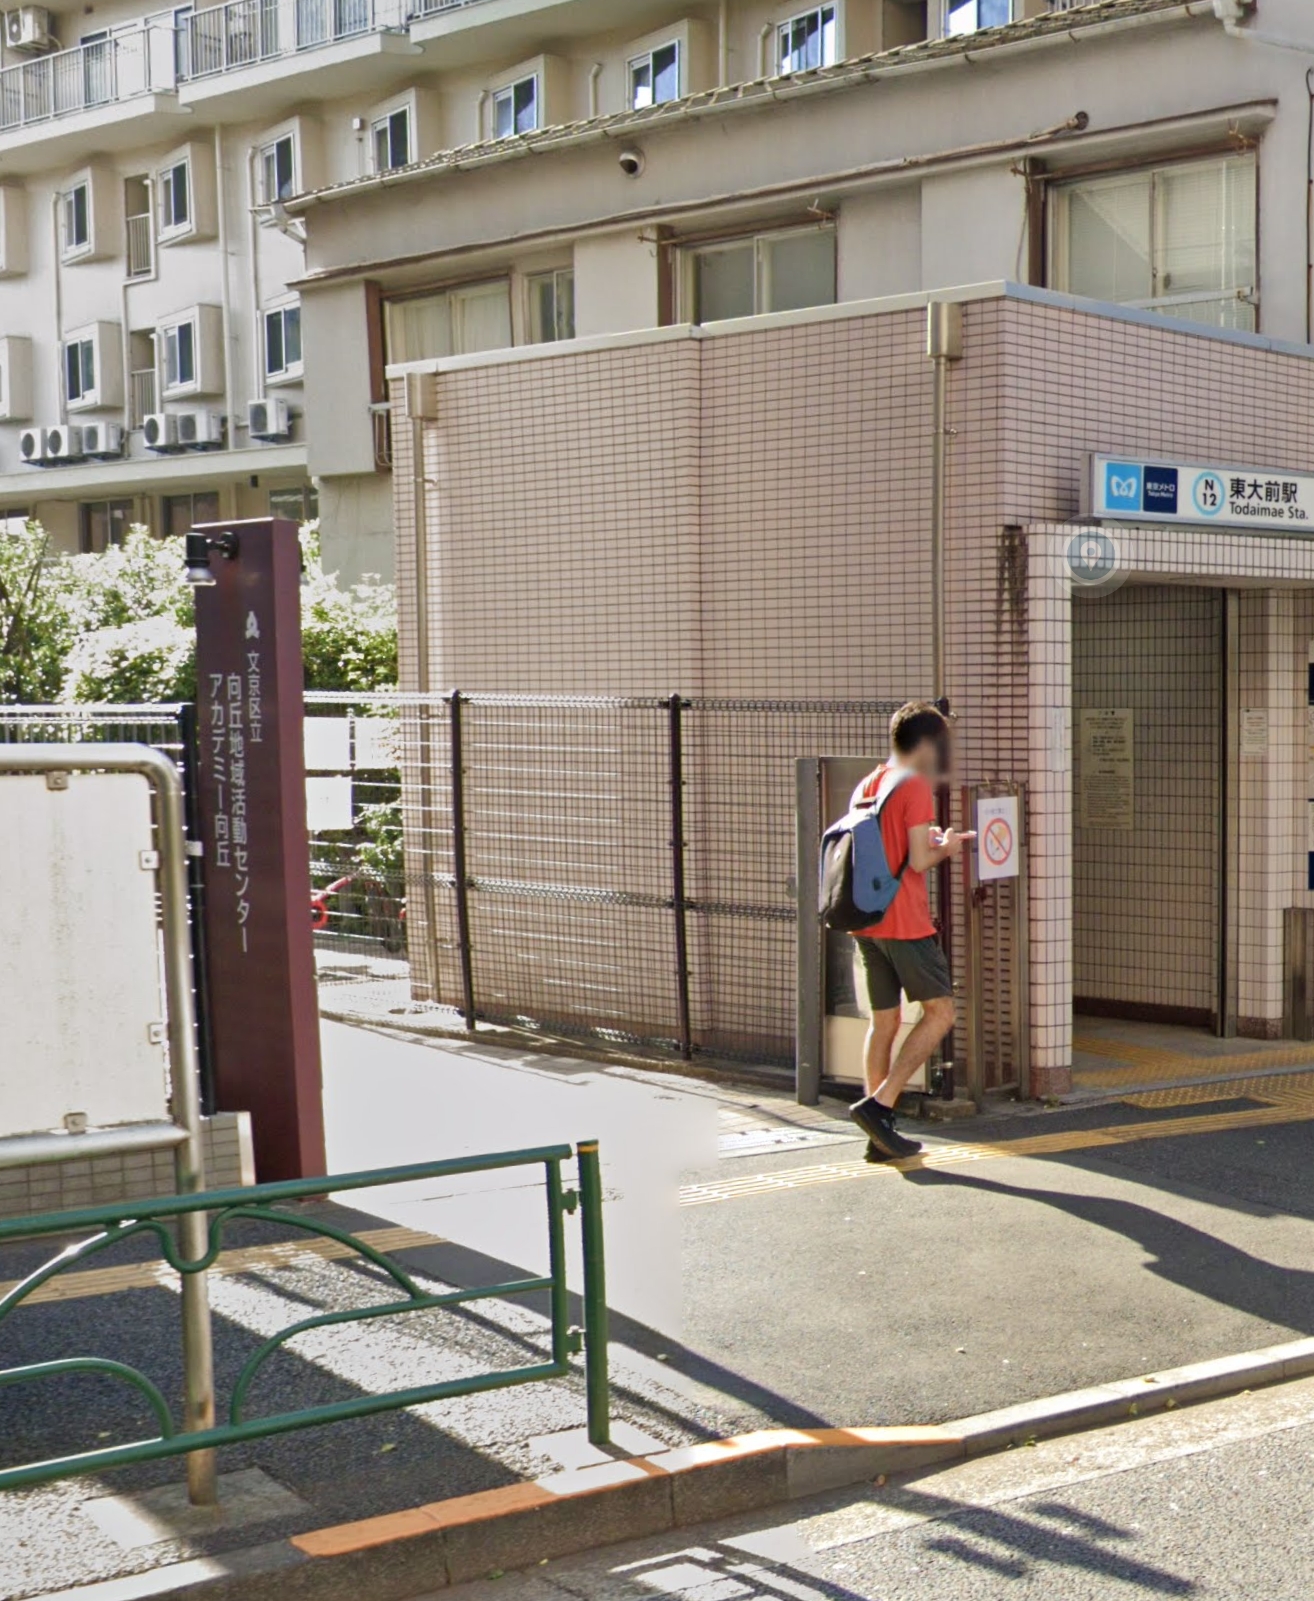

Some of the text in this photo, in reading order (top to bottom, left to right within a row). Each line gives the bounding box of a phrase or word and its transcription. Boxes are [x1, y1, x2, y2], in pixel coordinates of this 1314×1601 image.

[1145, 482, 1176, 492] 東京メトロ
[1204, 479, 1214, 491] N
[1229, 477, 1298, 503] 東大前駅
[1202, 493, 1217, 506] 12
[1229, 501, 1309, 520] Todaimae Sta.
[246, 649, 263, 743] 文京区立
[209, 673, 231, 868] アカデミー向丘
[227, 673, 250, 953] 向丘地域活動センター
